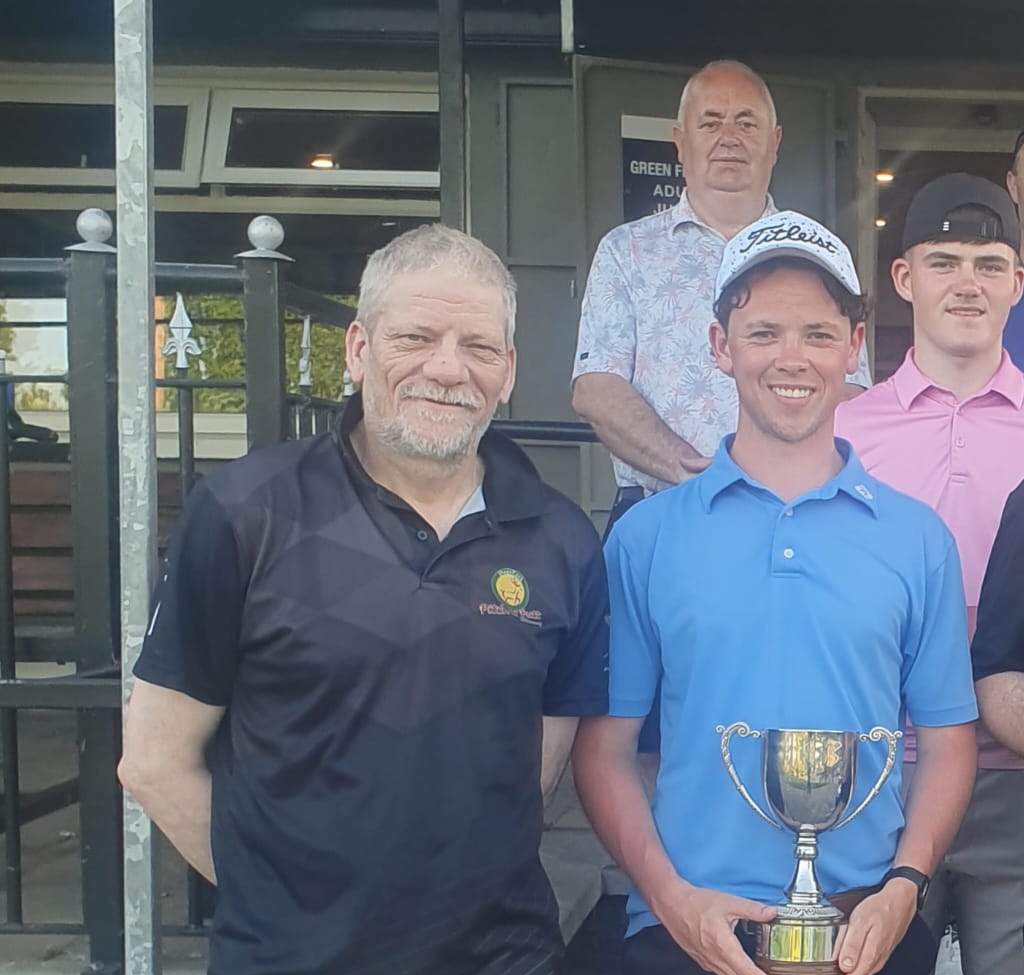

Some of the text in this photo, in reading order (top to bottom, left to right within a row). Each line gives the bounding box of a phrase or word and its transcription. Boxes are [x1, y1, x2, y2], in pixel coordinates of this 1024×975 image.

[630, 160, 672, 177] GREEN
[653, 184, 682, 198] ADU
[739, 222, 838, 253] Titleist
